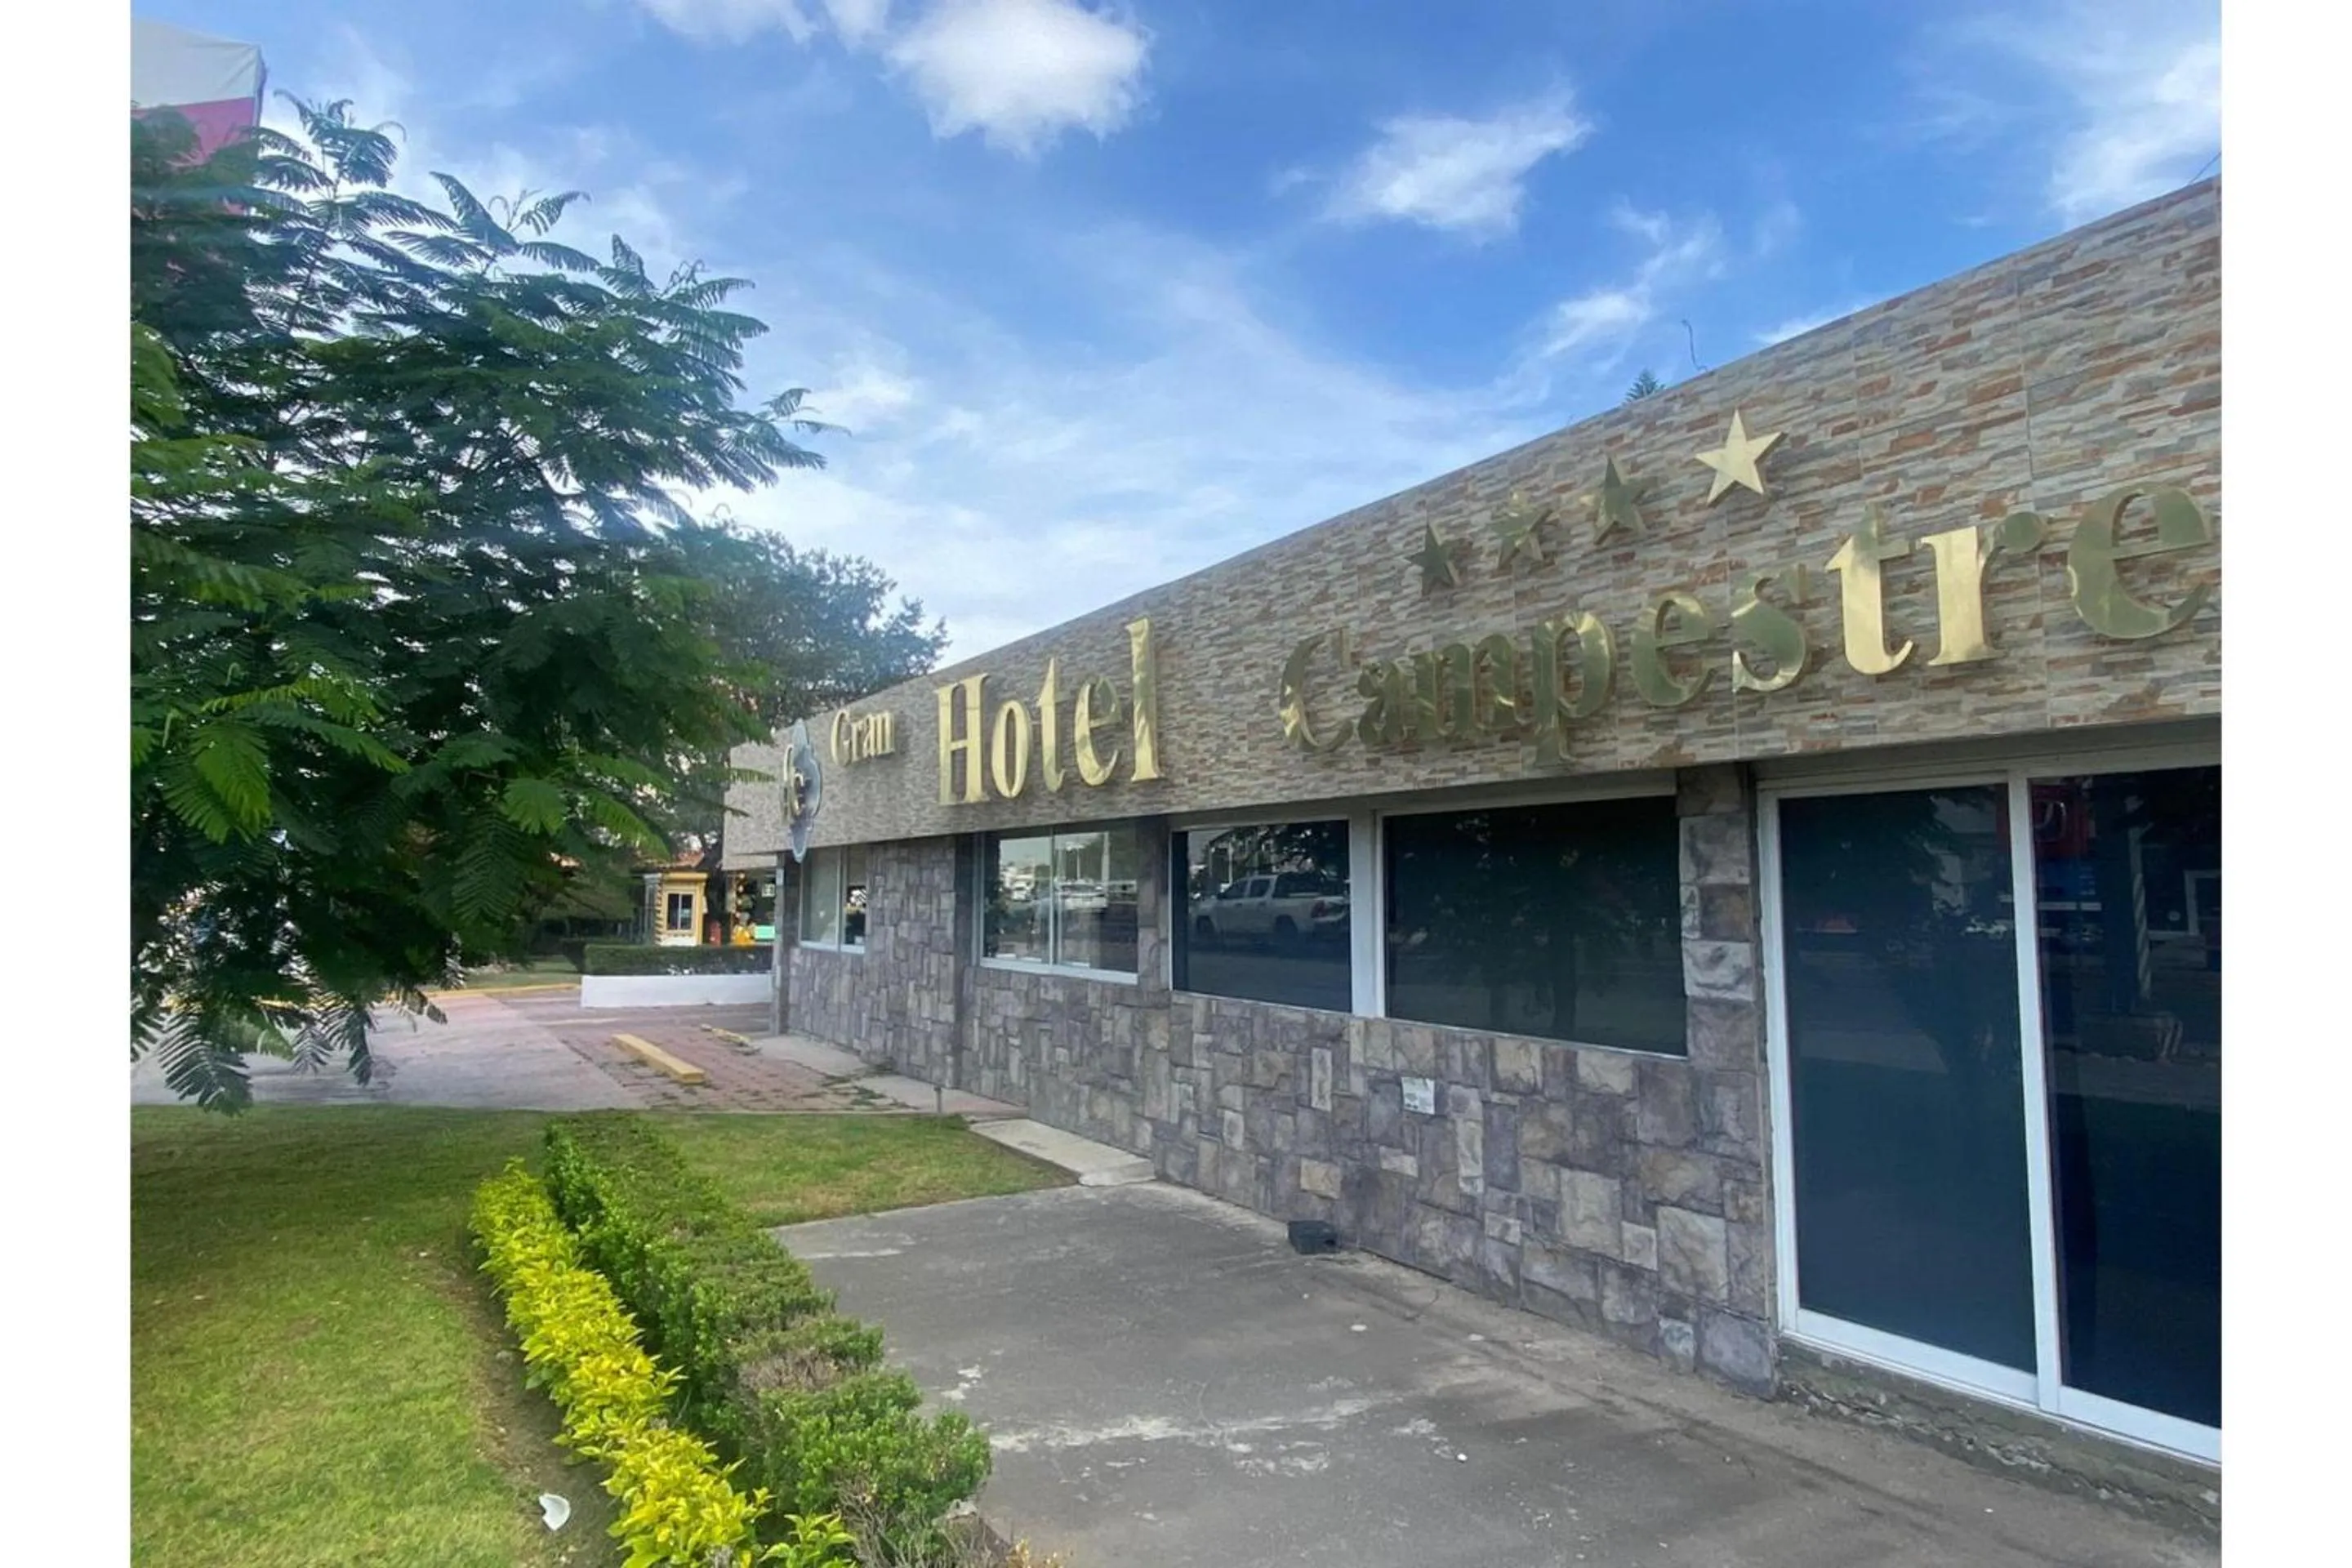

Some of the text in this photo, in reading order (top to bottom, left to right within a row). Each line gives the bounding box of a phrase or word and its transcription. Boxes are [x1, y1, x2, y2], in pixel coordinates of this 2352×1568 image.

[831, 709, 896, 766] Gran
[936, 618, 1163, 805] Hotel
[1279, 487, 2213, 765] Campestre
